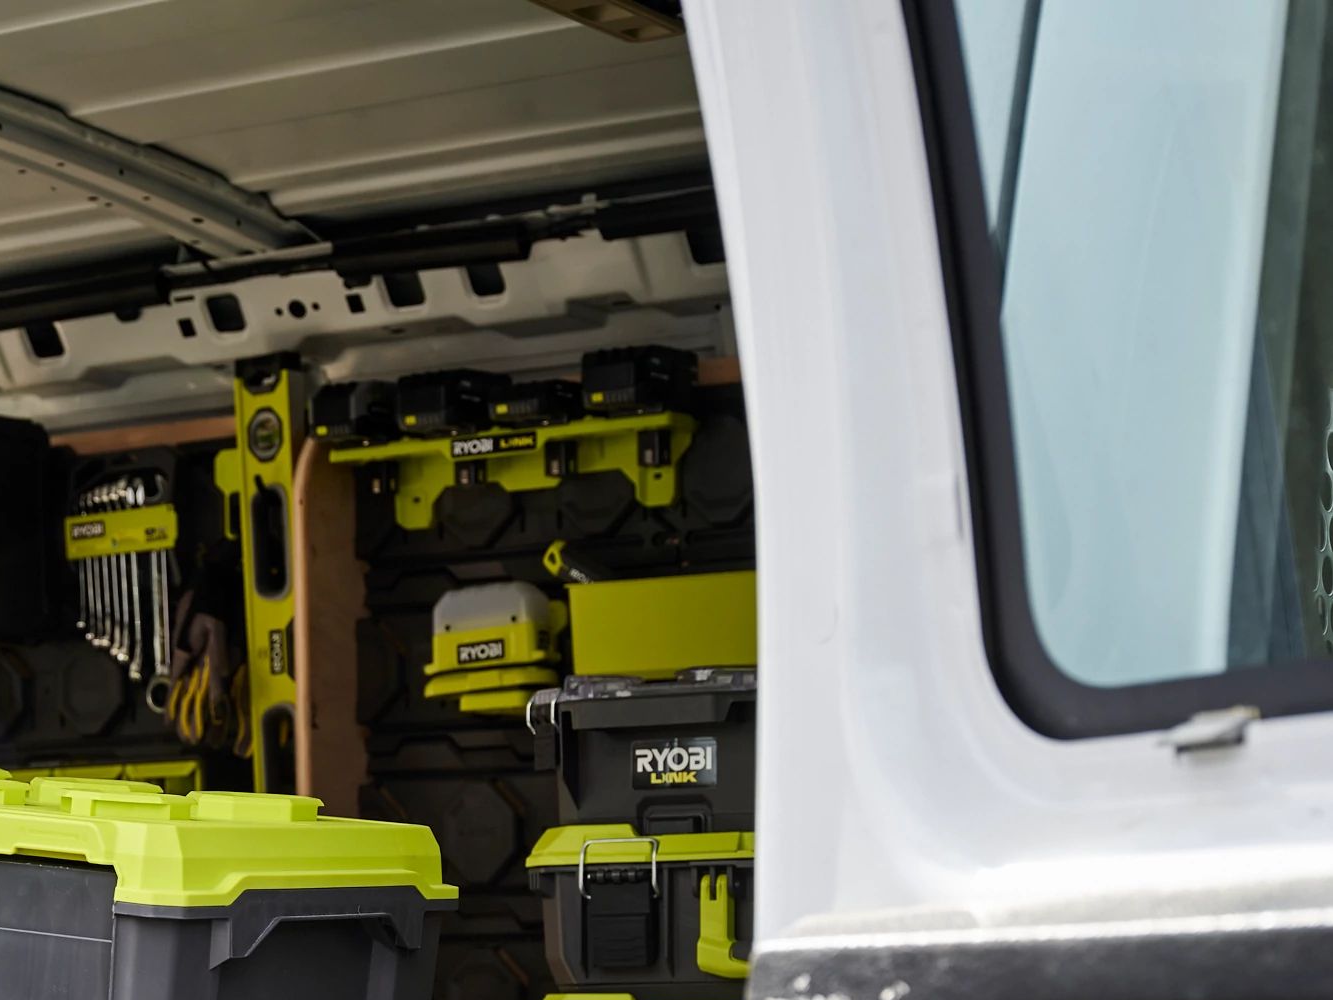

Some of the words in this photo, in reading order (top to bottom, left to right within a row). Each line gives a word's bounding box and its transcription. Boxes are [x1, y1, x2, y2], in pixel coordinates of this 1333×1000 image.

[453, 438, 494, 455] RYOBI
[459, 641, 503, 662] RYOBI
[635, 746, 712, 772] RYOBI
[650, 771, 697, 784] LINK
